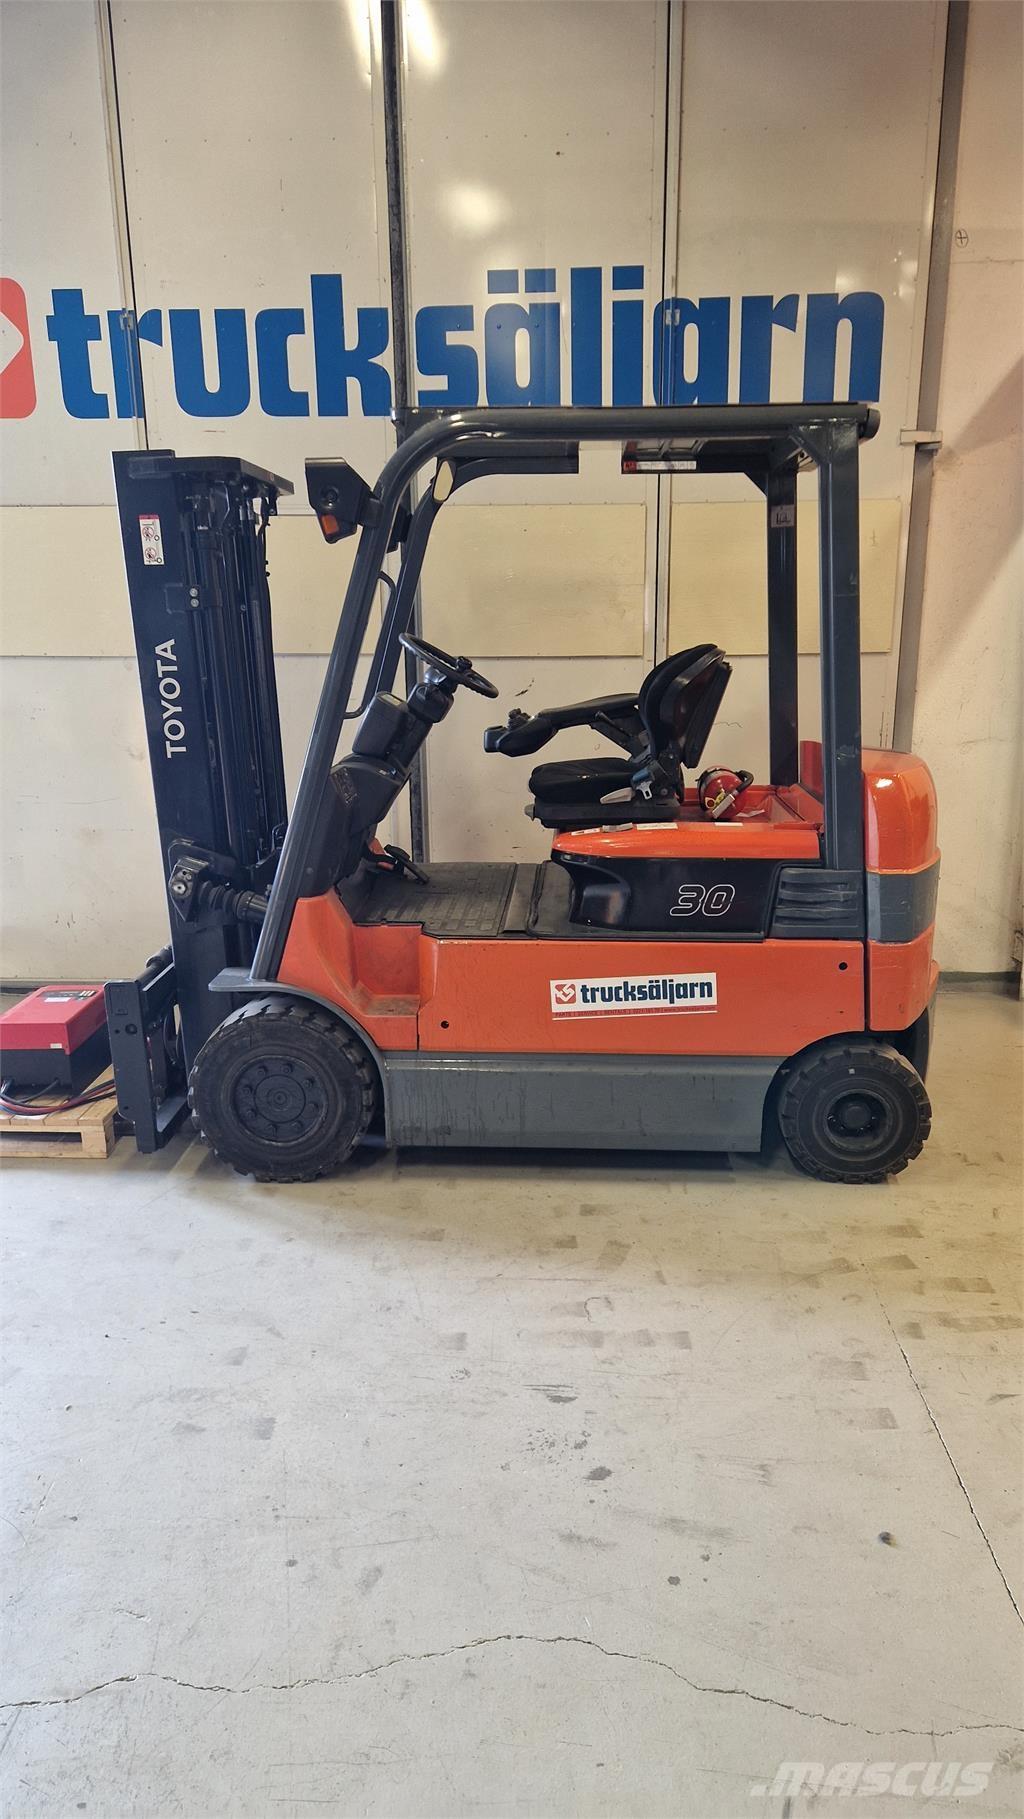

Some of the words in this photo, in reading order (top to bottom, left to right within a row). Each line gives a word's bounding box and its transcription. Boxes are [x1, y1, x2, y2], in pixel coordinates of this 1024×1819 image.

[155, 638, 187, 759] TOYOTA
[669, 884, 736, 917] 30
[580, 979, 713, 1004] trucksäljarn
